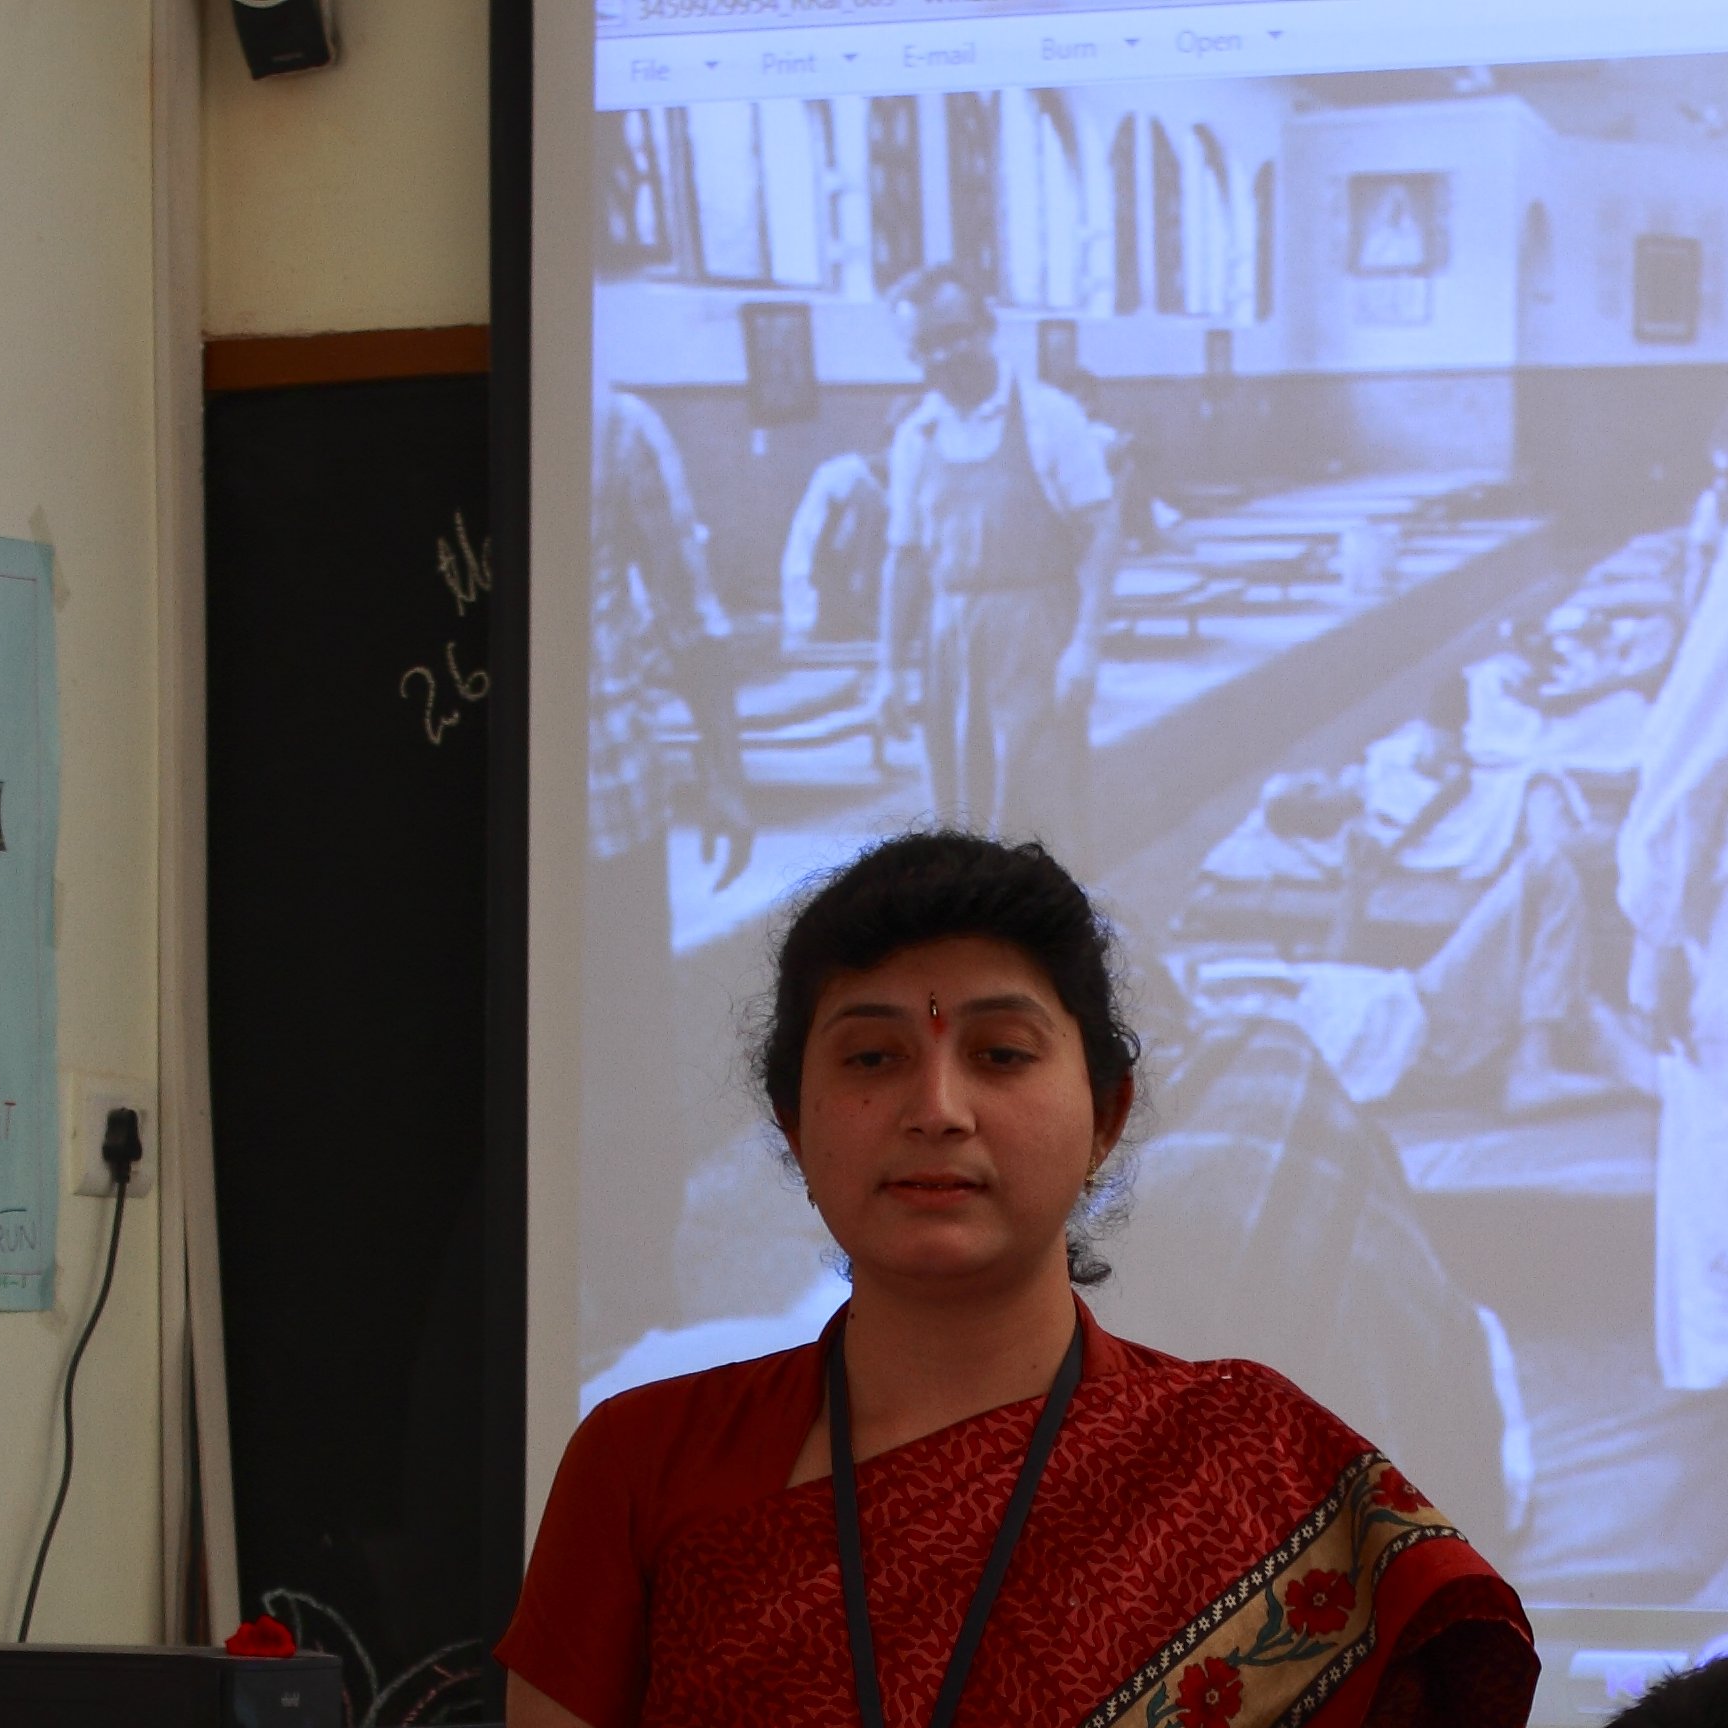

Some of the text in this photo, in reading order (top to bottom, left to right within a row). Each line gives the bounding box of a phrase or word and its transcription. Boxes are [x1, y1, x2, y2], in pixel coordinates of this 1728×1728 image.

[631, 28, 1243, 82] File Print E-mail Burn Open
